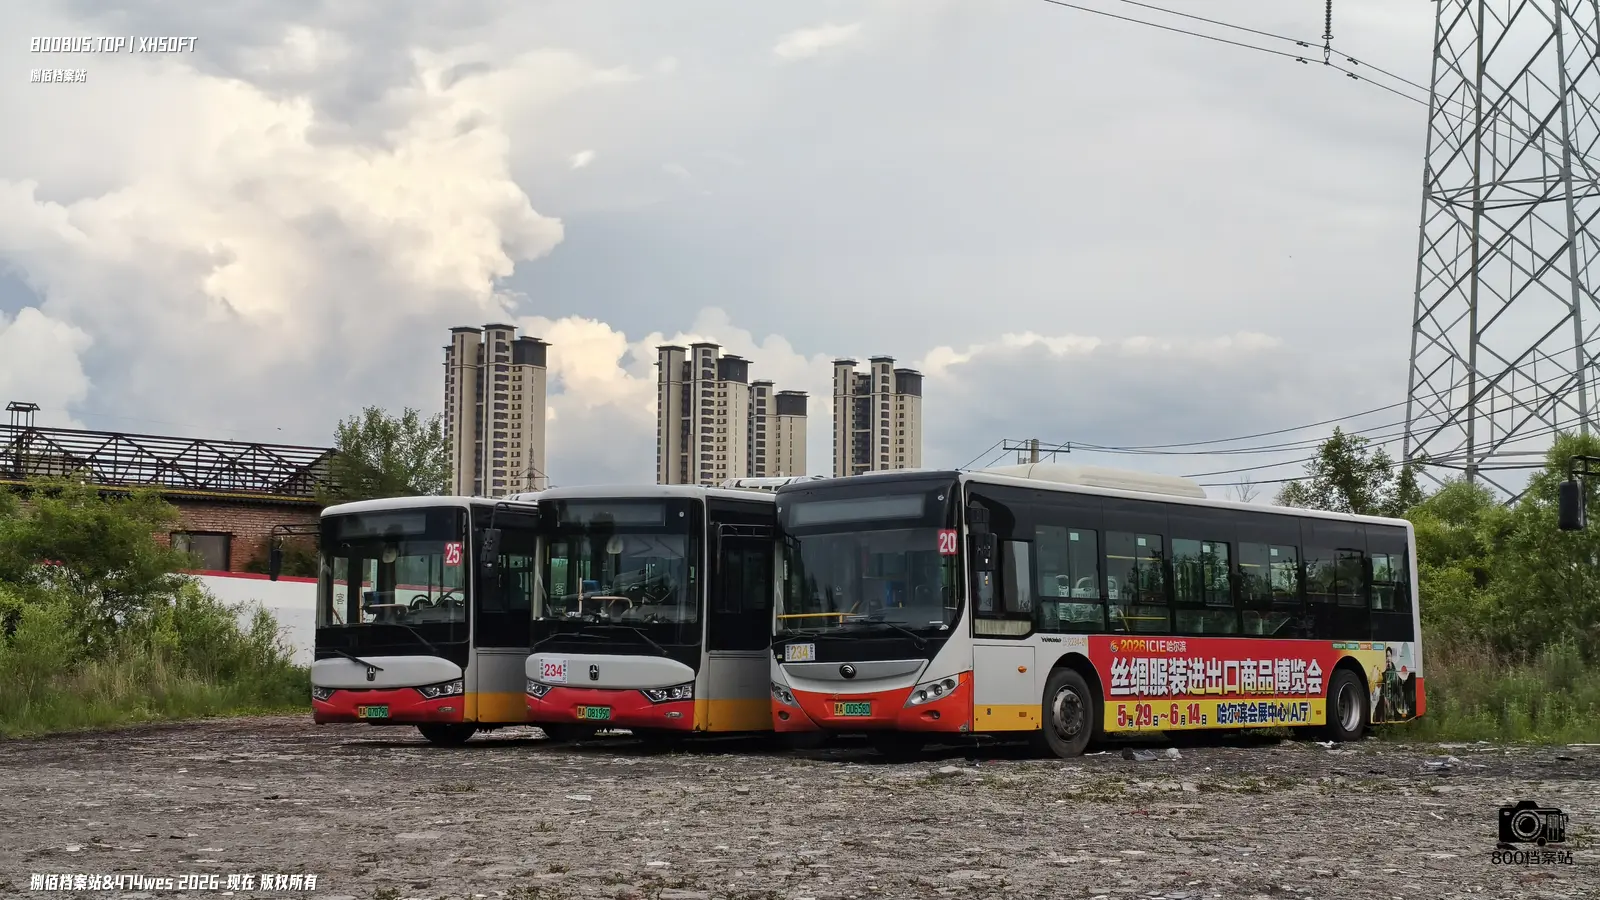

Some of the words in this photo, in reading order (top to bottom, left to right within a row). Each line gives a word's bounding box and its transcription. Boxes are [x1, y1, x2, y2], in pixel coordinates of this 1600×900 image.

[939, 531, 957, 553] 20
[446, 543, 460, 564] 25
[790, 645, 809, 660] 234
[544, 663, 563, 677] 234
[1110, 656, 1323, 696] 丝绸服装进出口商品博览会
